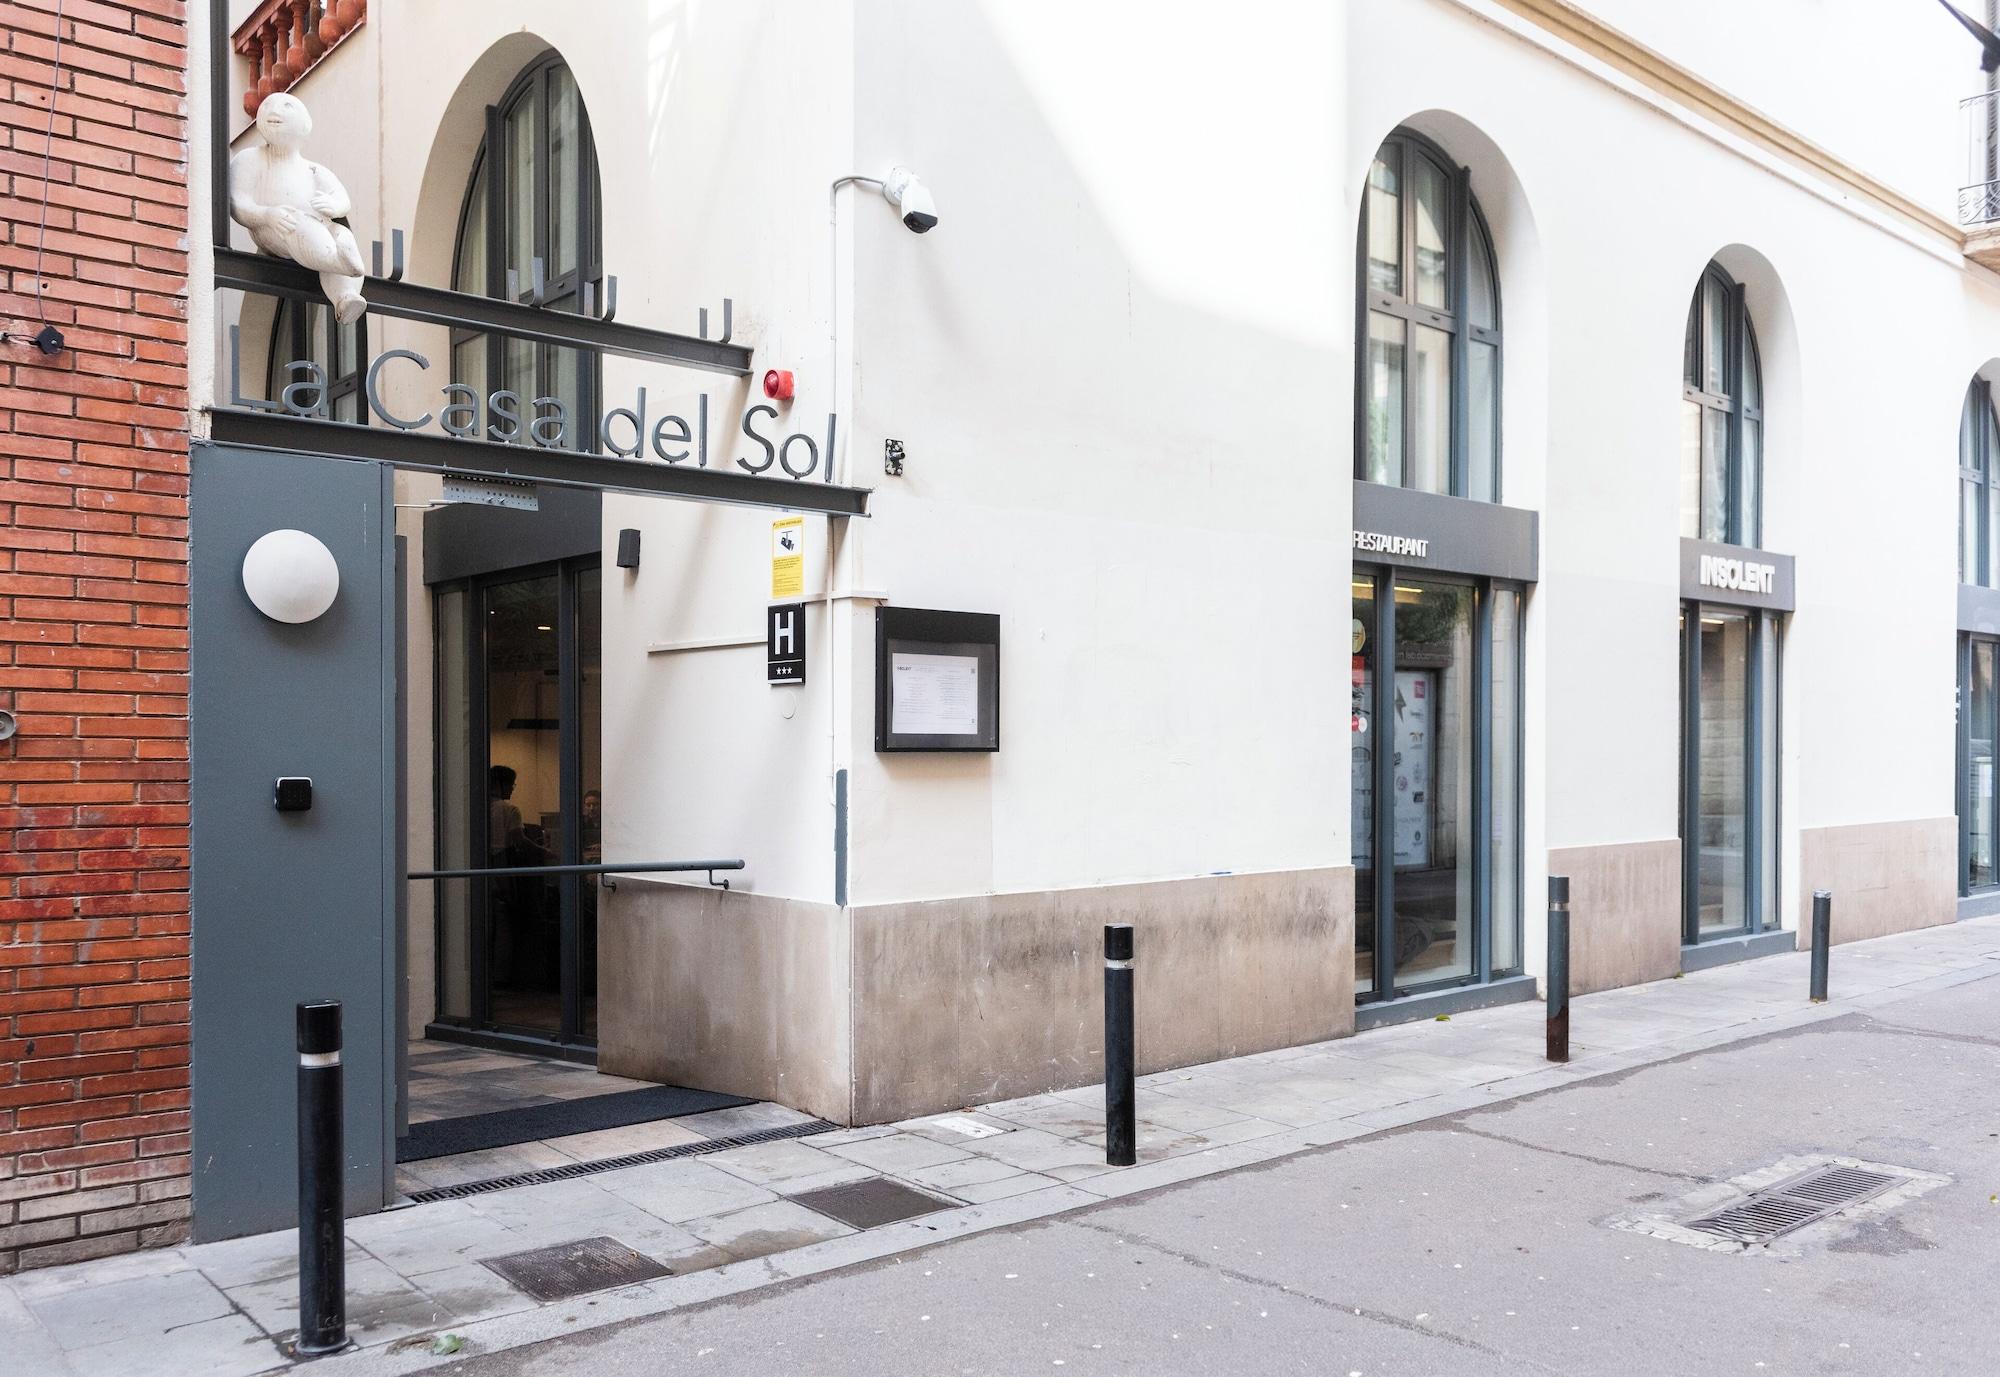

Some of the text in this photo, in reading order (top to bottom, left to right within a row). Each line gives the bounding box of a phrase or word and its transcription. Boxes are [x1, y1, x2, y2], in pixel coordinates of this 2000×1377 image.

[231, 325, 837, 482] La Casa del Sol
[1353, 530, 1428, 557] RESTAURANT
[1700, 554, 1776, 594] INSOLENT
[774, 611, 794, 654] H
